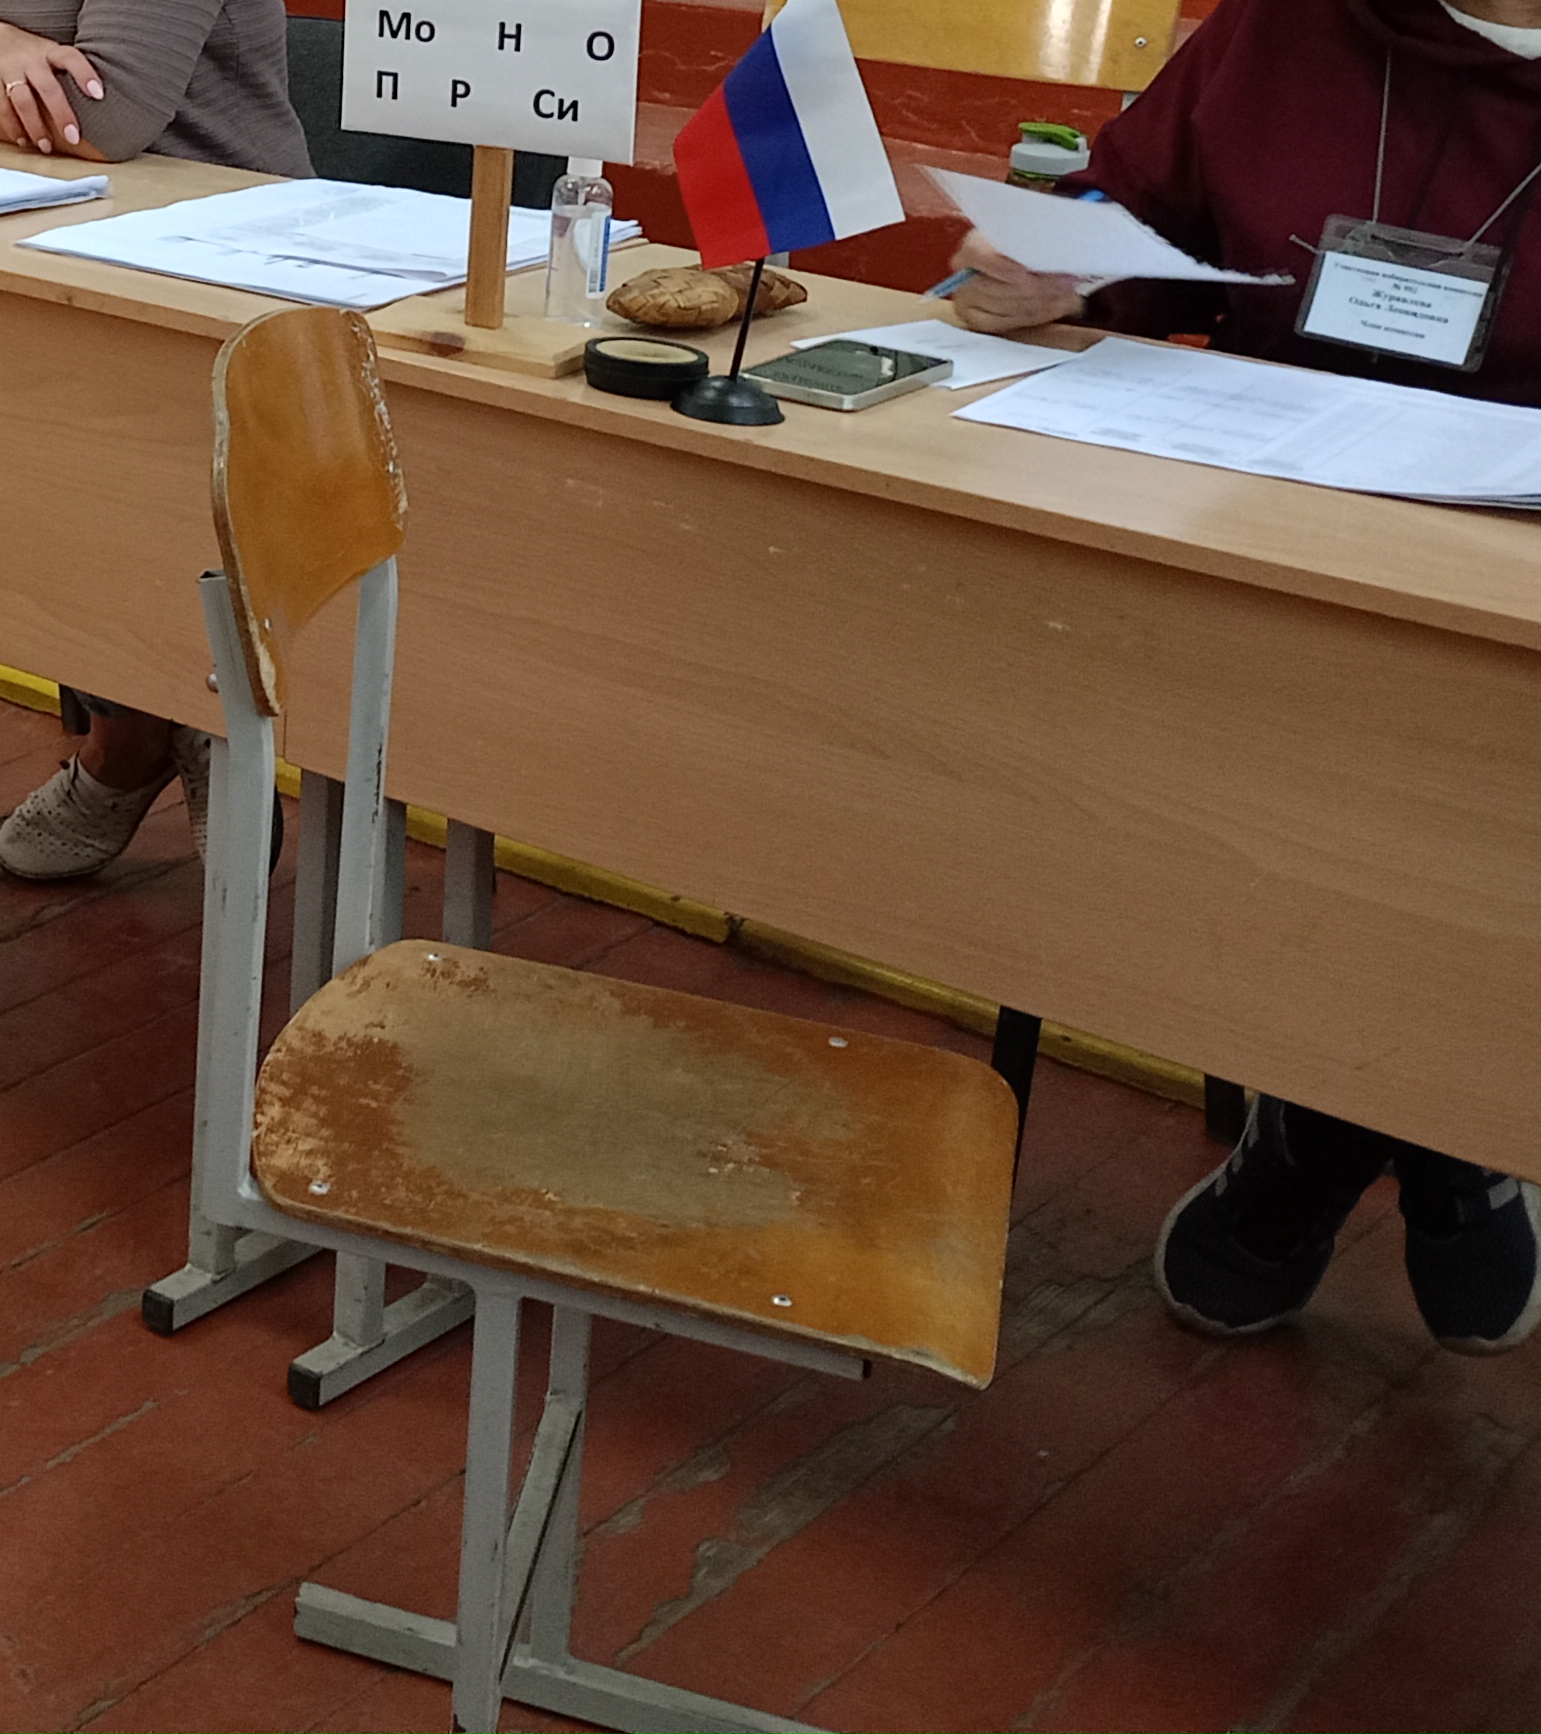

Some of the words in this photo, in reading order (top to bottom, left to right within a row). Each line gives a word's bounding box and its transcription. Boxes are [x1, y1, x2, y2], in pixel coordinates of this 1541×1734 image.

[378, 9, 436, 43] Мо
[497, 21, 522, 52] Н
[586, 31, 615, 61] О
[375, 70, 399, 100] П
[451, 79, 471, 108] Р
[532, 89, 579, 122] Си
